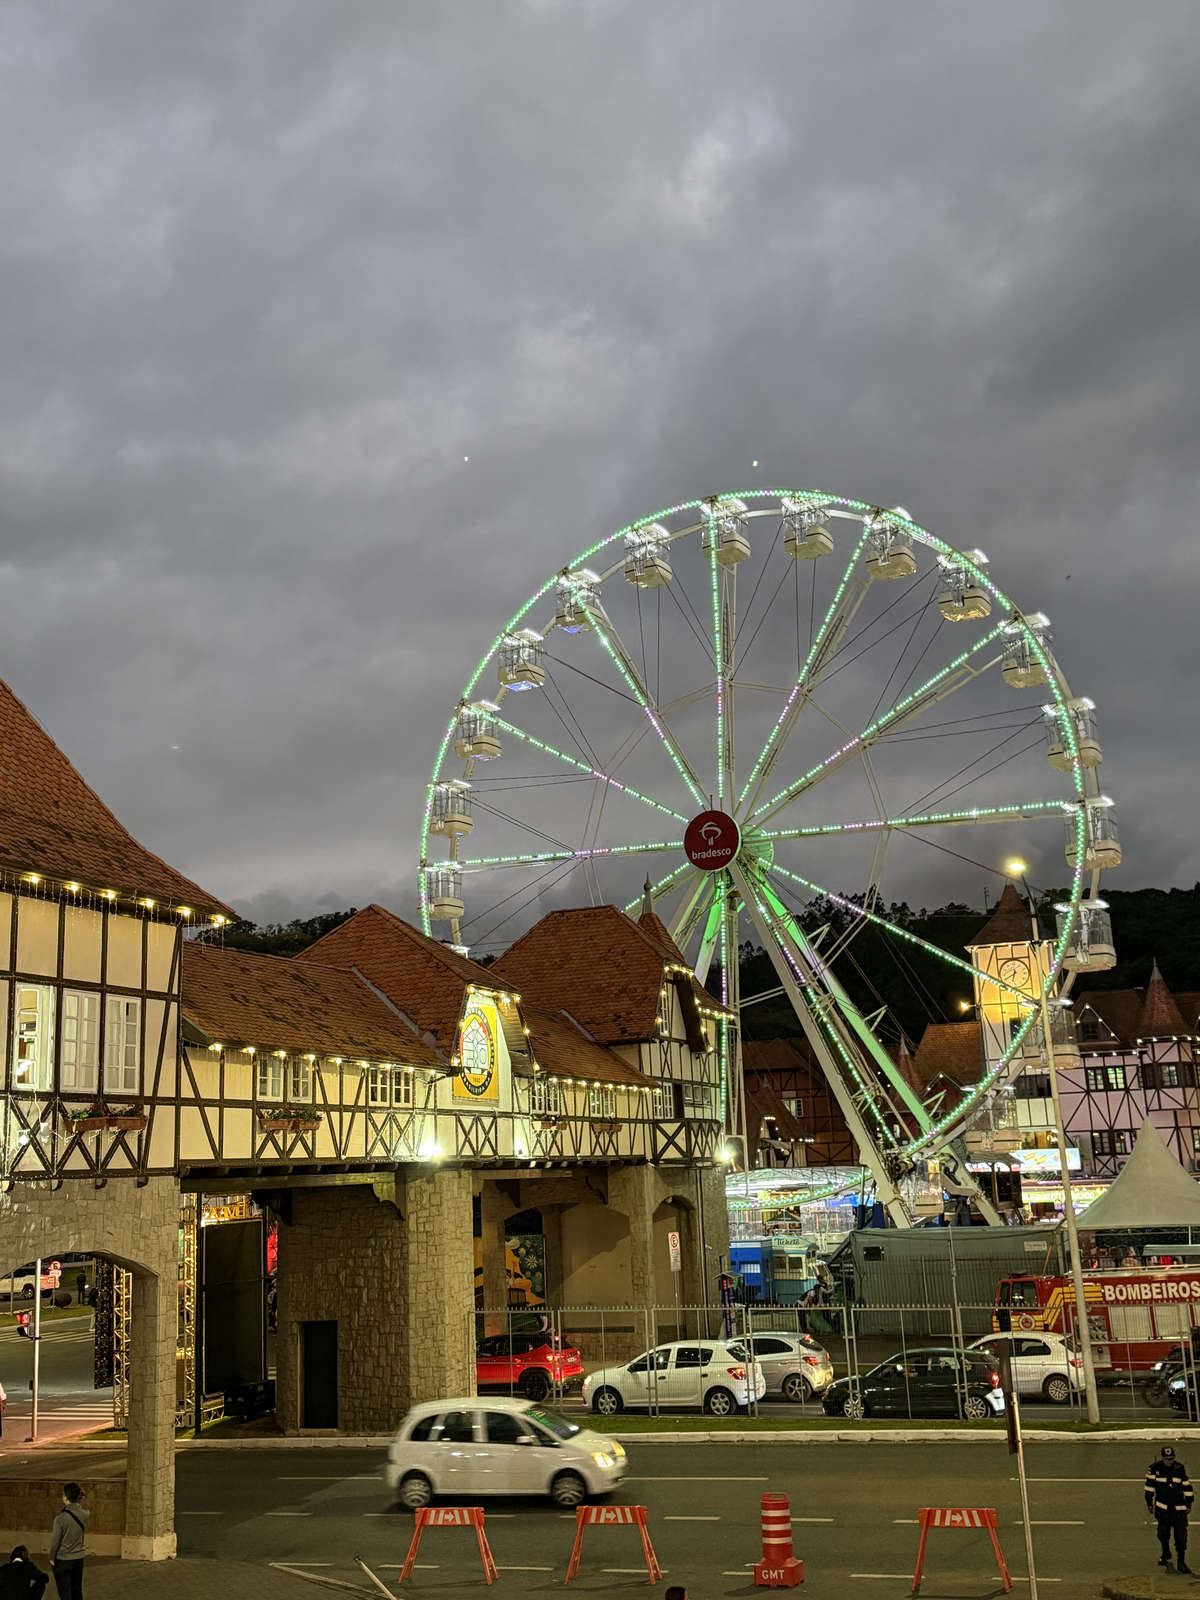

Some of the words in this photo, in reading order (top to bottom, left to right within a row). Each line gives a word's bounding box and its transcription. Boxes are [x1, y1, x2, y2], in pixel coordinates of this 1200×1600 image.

[692, 847, 731, 860] bradesco
[1104, 1280, 1200, 1301] BOMBEIROS
[761, 1569, 785, 1580] GMT
